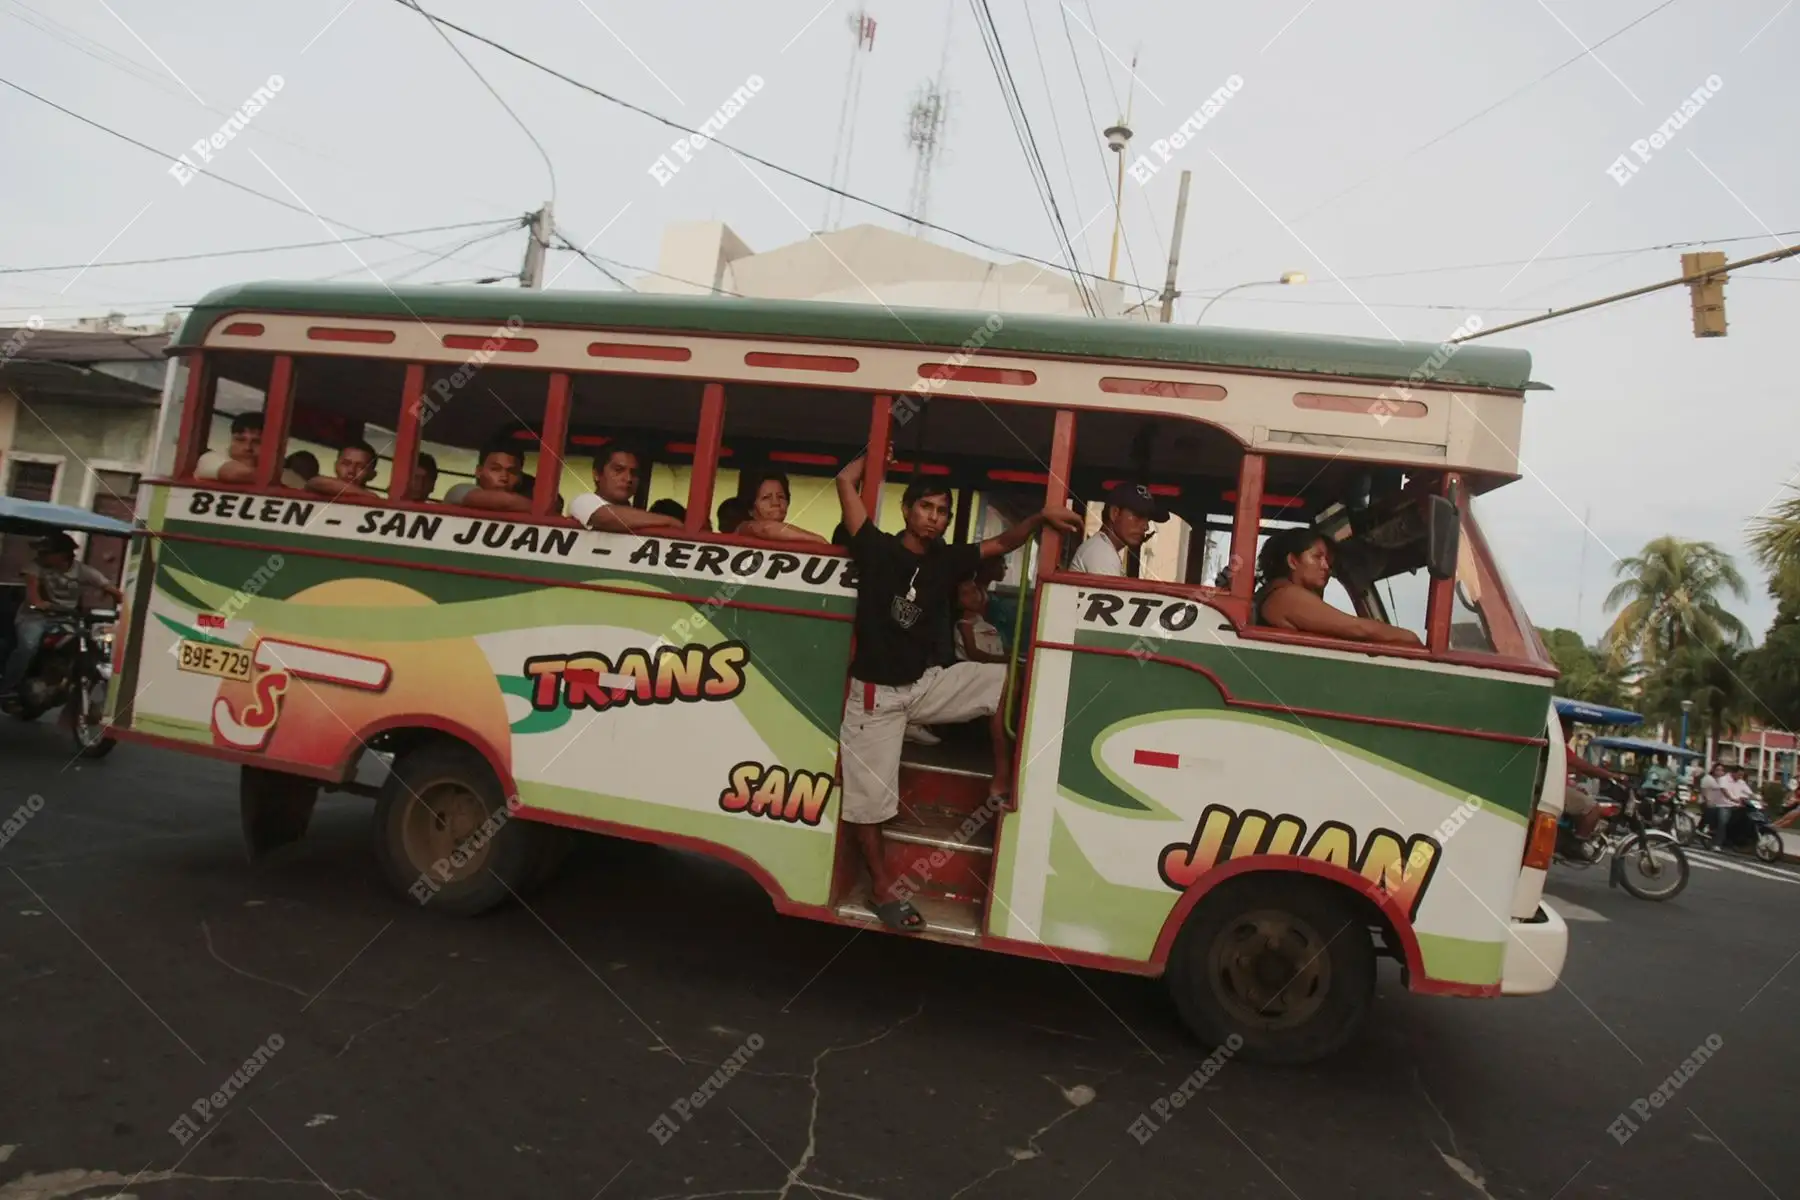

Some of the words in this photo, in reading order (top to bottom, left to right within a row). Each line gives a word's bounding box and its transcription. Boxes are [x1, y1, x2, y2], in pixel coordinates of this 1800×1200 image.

[189, 491, 313, 528] BELEN
[357, 510, 443, 542] SAN
[454, 520, 579, 556] JUAN
[182, 644, 250, 675] B9E-729
[524, 643, 749, 712] TRANS
[719, 761, 834, 827] SAN
